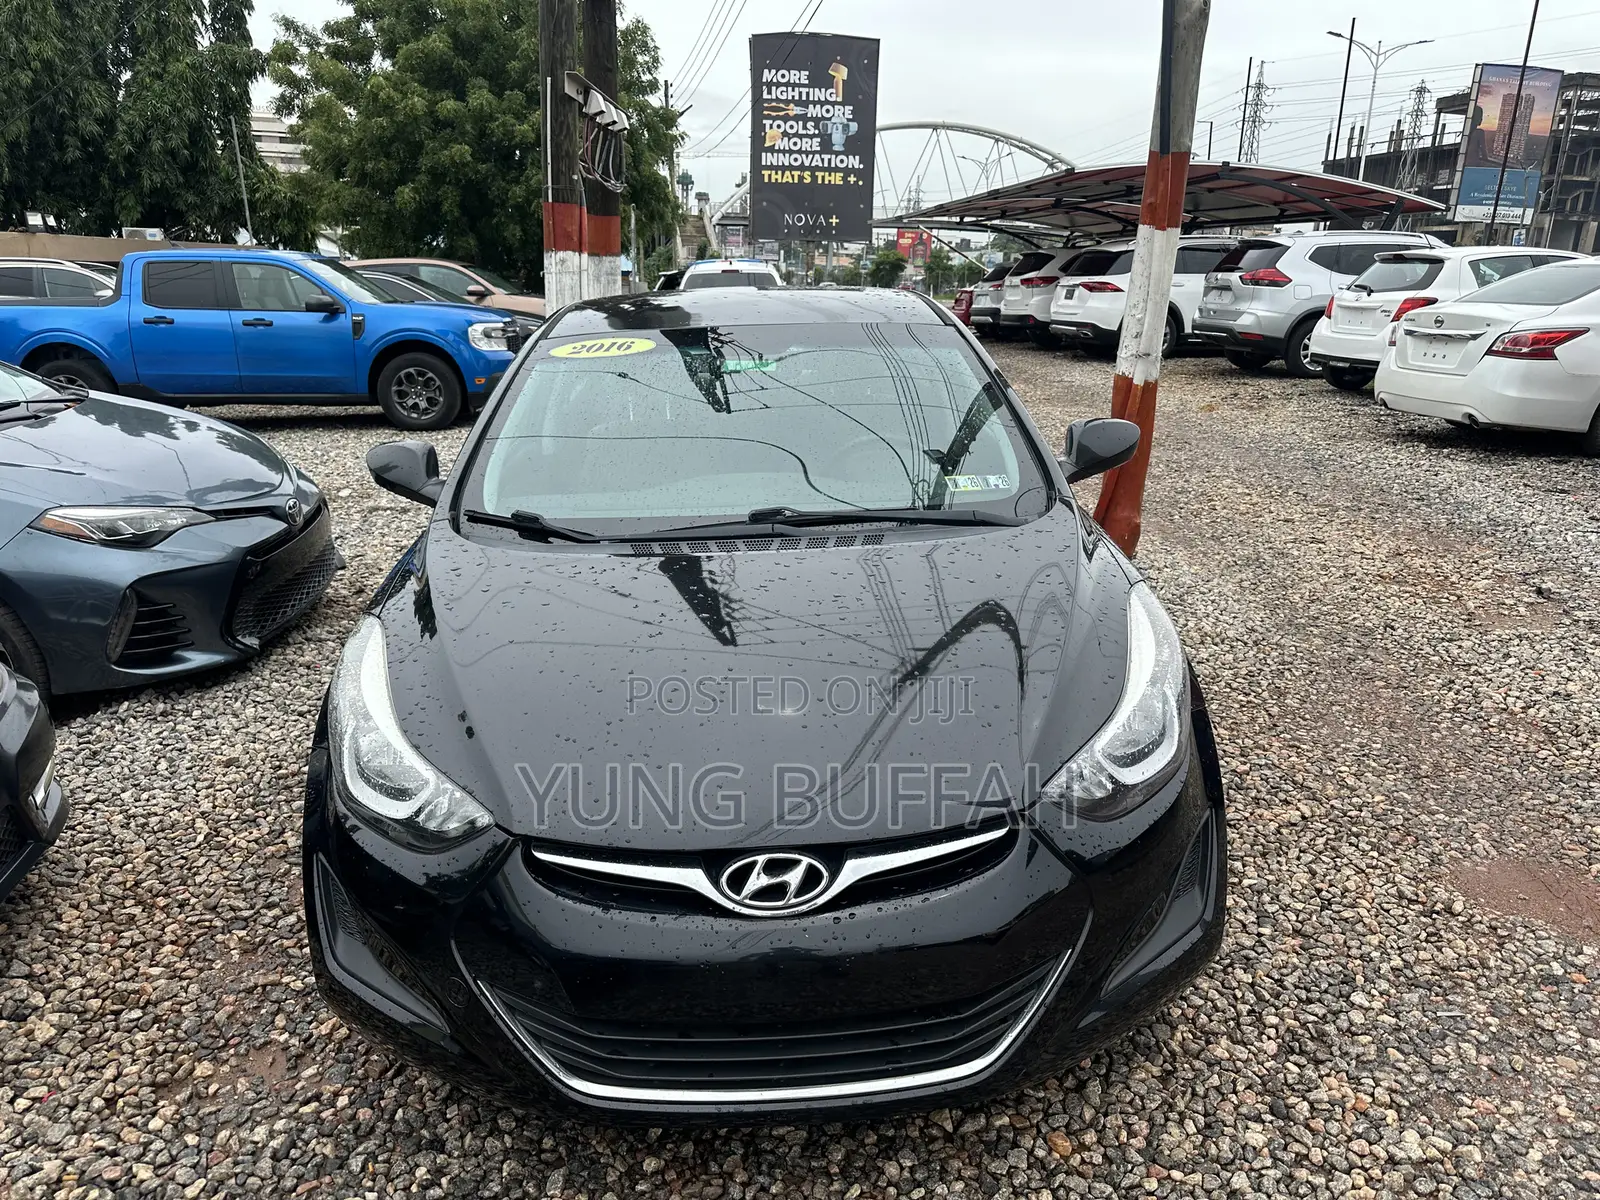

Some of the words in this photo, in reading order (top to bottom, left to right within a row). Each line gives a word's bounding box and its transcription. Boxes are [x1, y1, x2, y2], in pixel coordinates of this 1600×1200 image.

[762, 69, 809, 84] MORE
[762, 86, 842, 102] LIGHTING.
[807, 104, 853, 119] MORE
[763, 119, 819, 135] TOOLS.
[774, 137, 820, 151] MORE
[761, 153, 864, 169] INNOVATION.
[762, 170, 811, 183] THAT'S
[815, 172, 843, 185] THE
[566, 340, 636, 355] 2016
